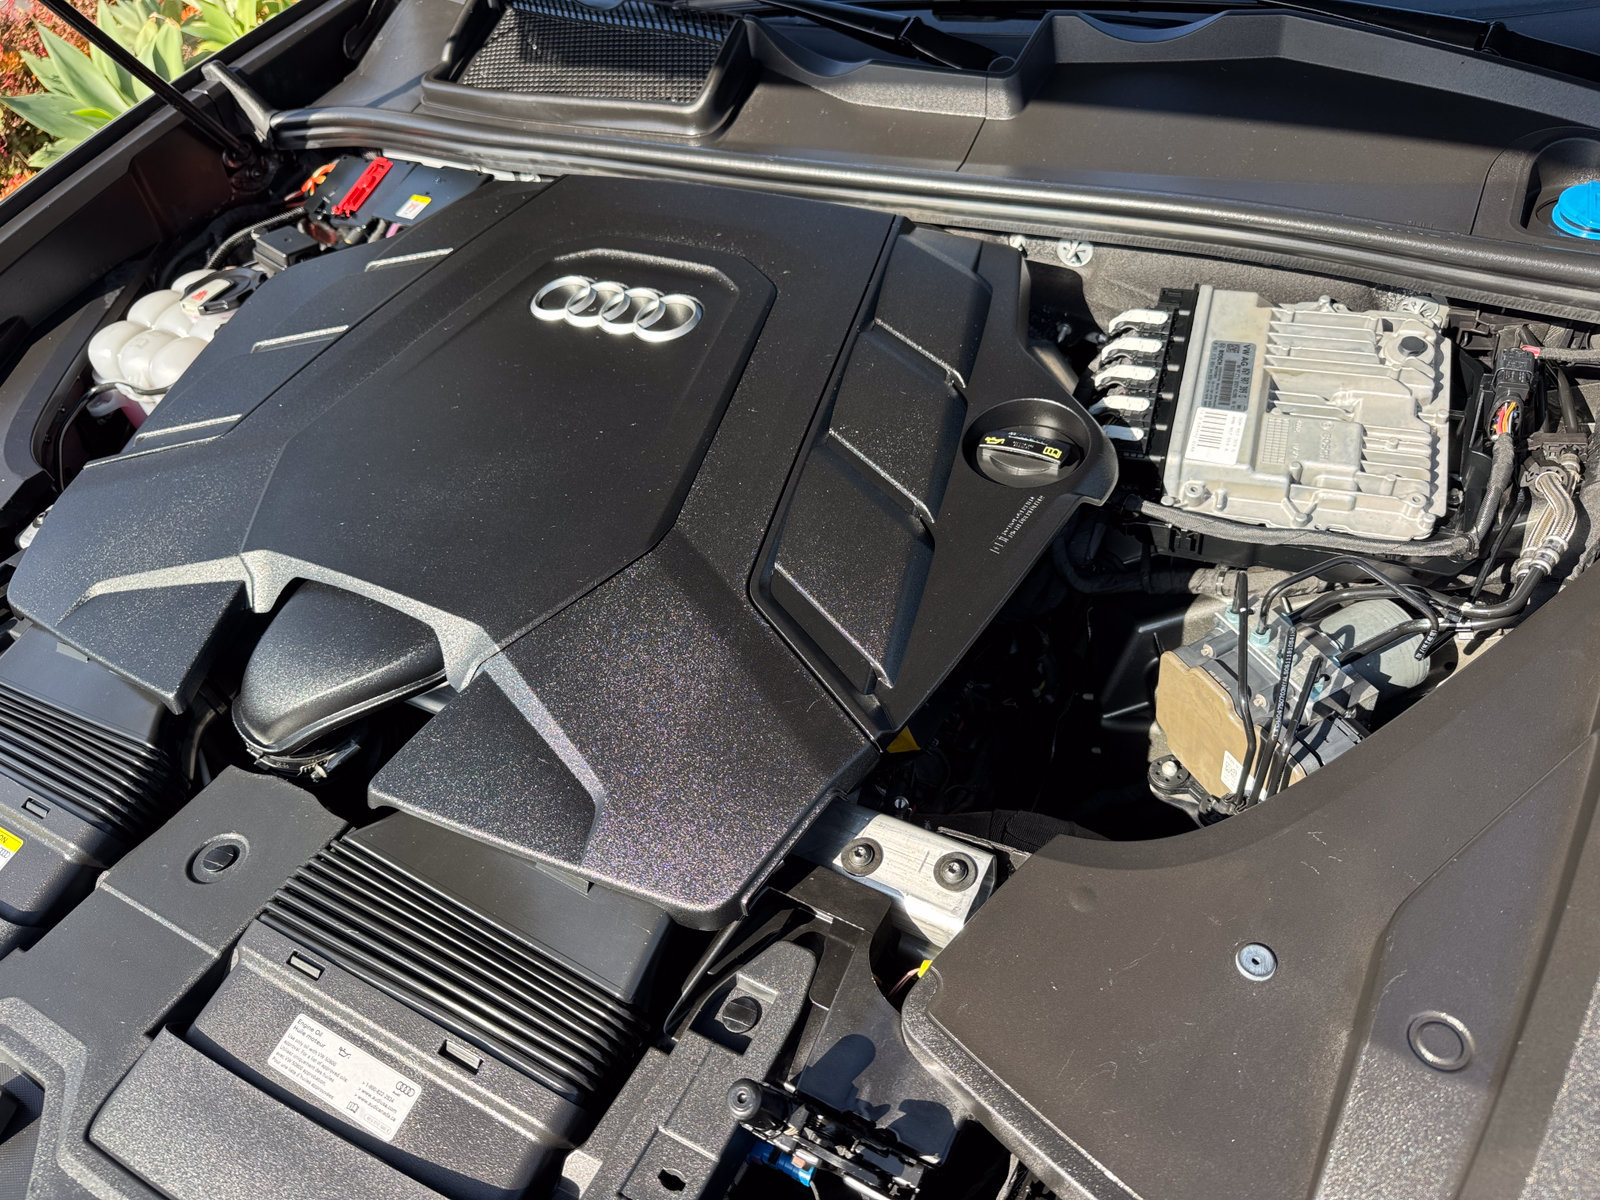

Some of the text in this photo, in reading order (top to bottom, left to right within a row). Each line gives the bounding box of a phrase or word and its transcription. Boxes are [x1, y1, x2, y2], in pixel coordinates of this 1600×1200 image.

[1216, 349, 1224, 365] BOSCH
[1242, 344, 1250, 355] VW
[1240, 356, 1248, 366] AG
[297, 1019, 323, 1037] Engine Oil
[287, 1033, 295, 1041] Use
[293, 1025, 325, 1048] Huile moteur
[272, 1056, 281, 1064] Pour
[279, 1045, 293, 1056] Utilisez
[293, 1054, 315, 1070] uniquement
[322, 1072, 334, 1082] huiles
[321, 1064, 340, 1077] approved
[357, 1095, 396, 1121] www.audicanada.ca
[361, 1089, 397, 1113] www.audiusa.com
